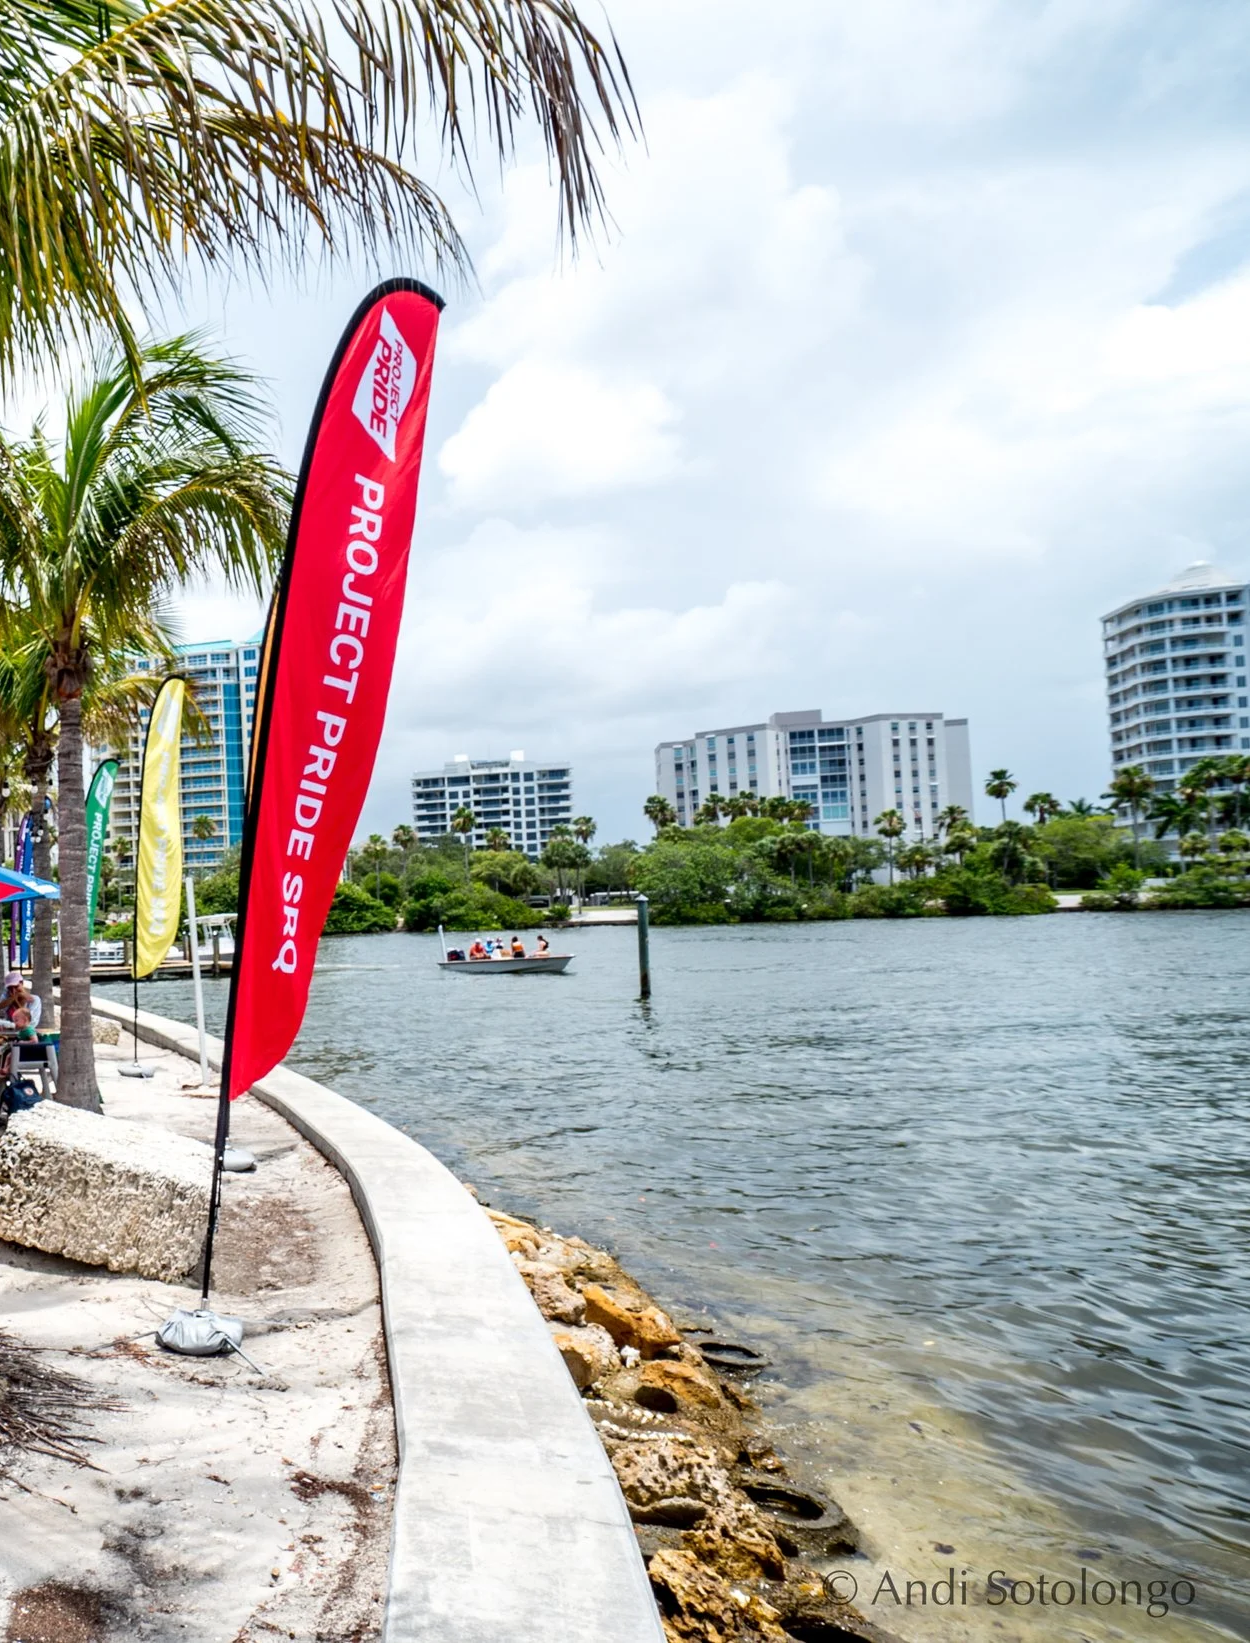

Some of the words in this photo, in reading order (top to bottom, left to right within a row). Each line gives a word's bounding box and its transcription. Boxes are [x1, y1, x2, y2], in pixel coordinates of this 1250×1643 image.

[369, 336, 392, 439] PRIDE
[389, 337, 403, 427] PROJECT
[322, 473, 385, 705] PROJECT
[286, 710, 347, 861] PRIDE
[87, 812, 104, 874] PROJECT
[271, 872, 304, 975] SRQ
